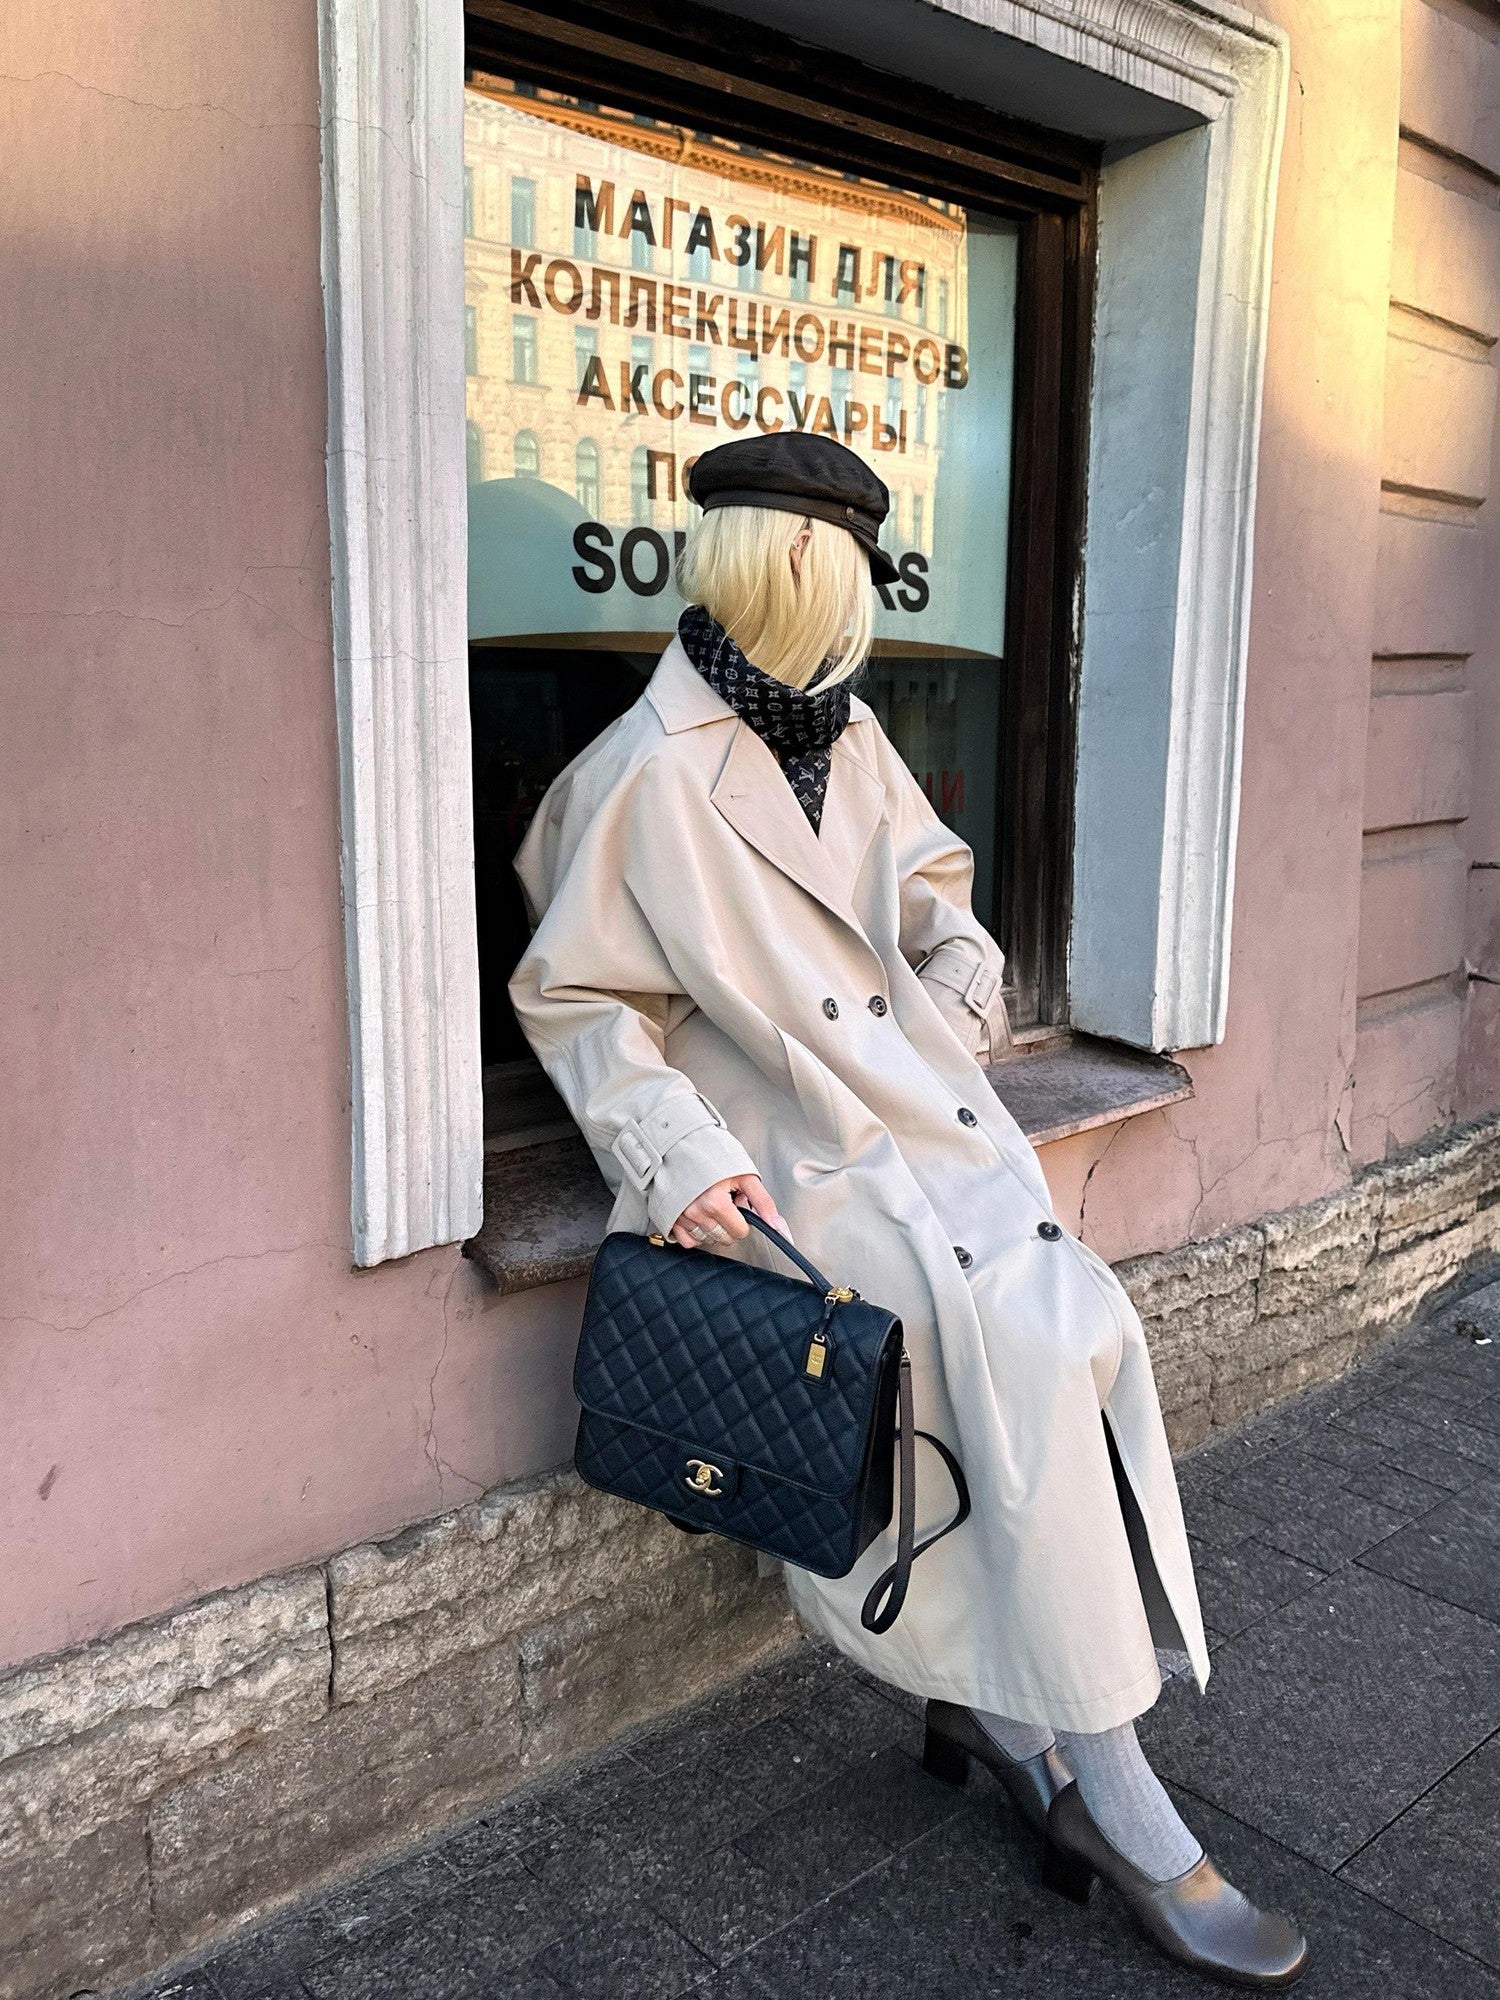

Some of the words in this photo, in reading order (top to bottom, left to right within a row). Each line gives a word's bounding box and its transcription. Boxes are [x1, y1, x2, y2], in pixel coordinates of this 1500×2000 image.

[574, 173, 818, 284] МАГАЗИН
[831, 242, 925, 308] ДЛЯ
[510, 248, 969, 390] КОЛЛЕКЦИОНЕРОВ
[576, 355, 907, 454] АКСЕССУАРЫ
